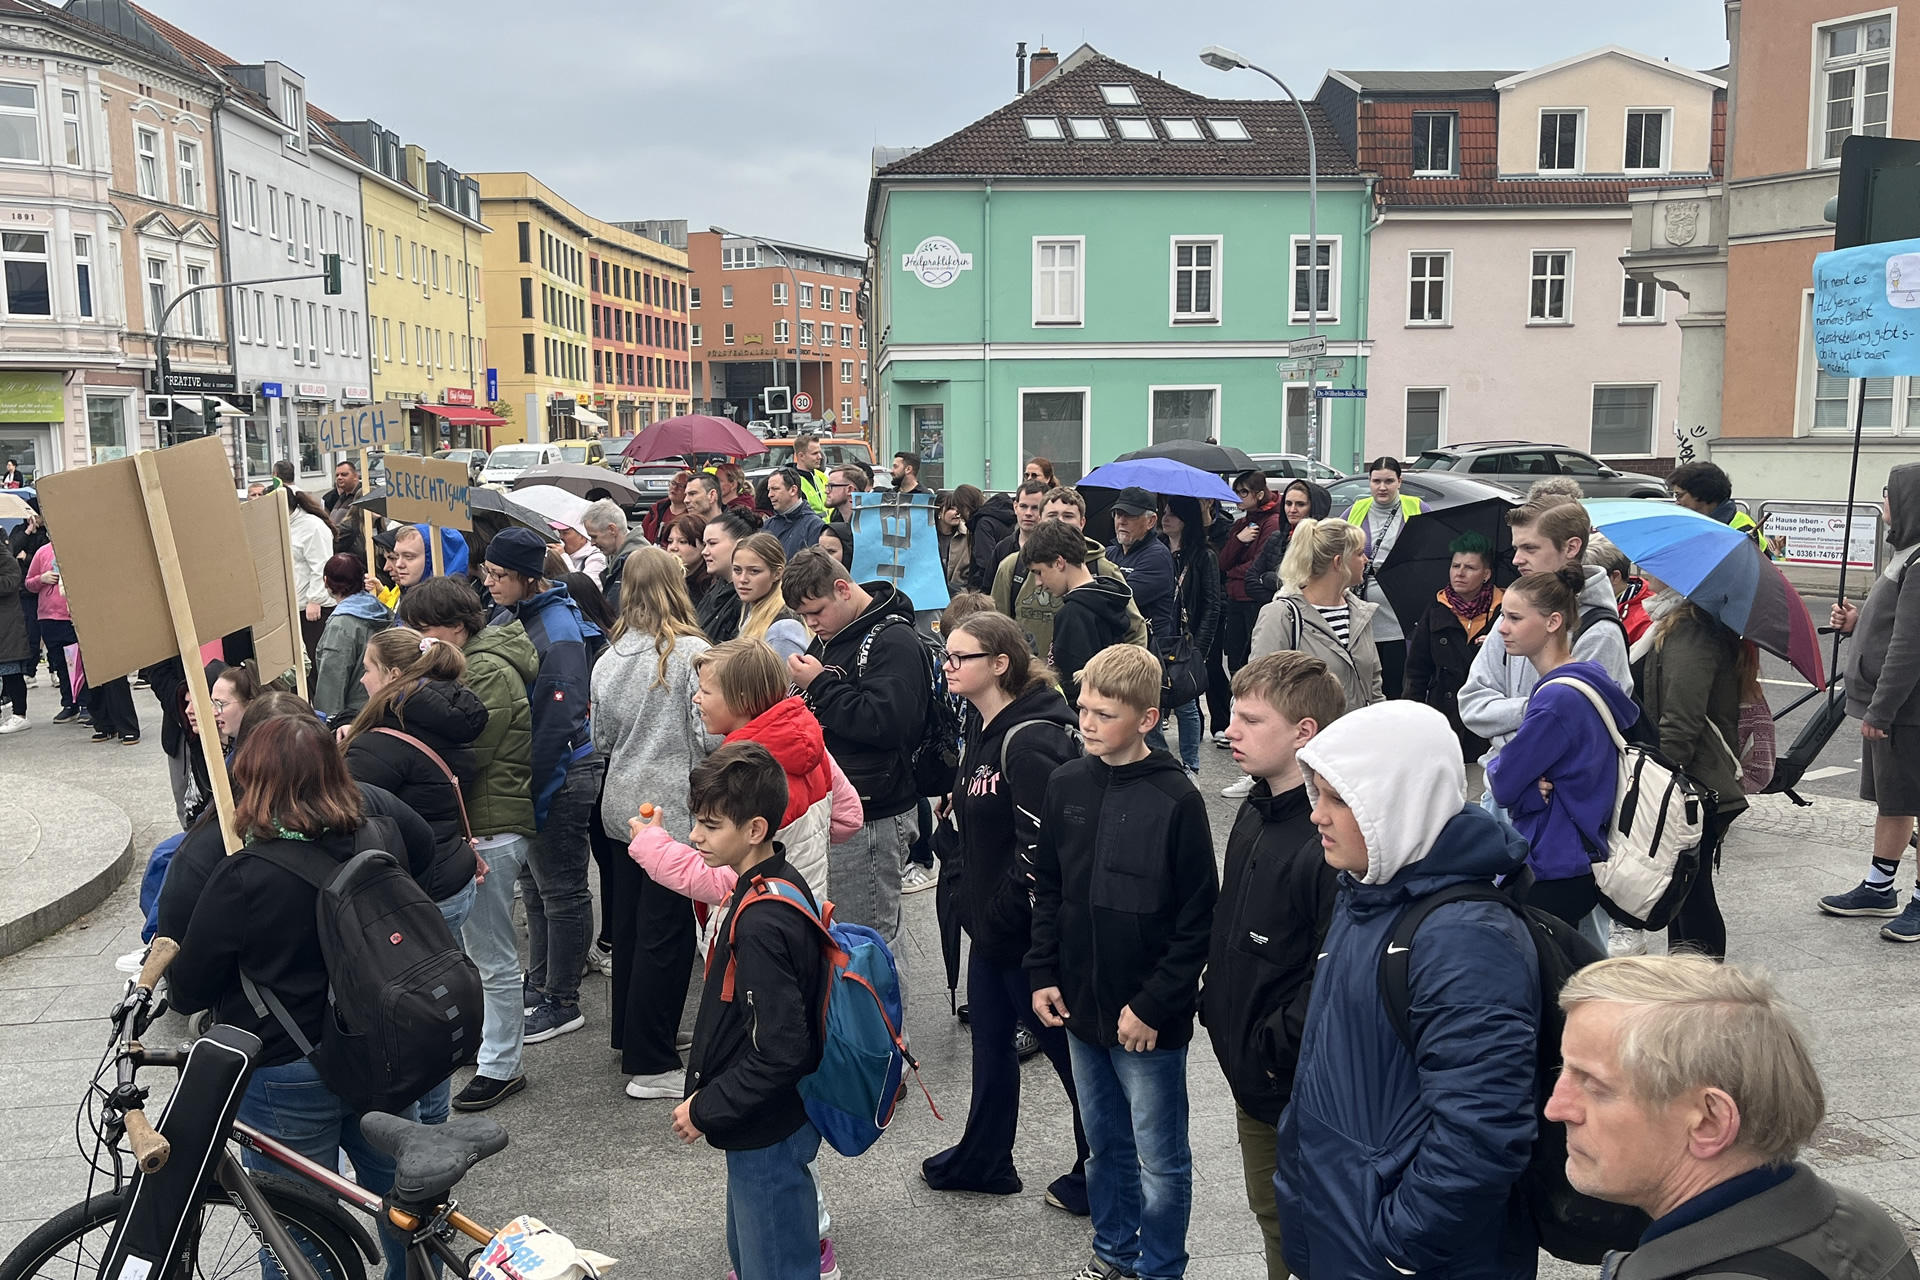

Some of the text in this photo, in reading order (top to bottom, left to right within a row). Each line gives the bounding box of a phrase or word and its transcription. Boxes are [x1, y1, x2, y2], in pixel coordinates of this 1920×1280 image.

[12, 213, 34, 221] 1891
[905, 255, 970, 271] Heilpraktikerin
[1853, 275, 1868, 285] es
[796, 397, 808, 407] 30
[320, 410, 399, 451] GLEICH-
[1775, 516, 1797, 524] Hause
[1799, 517, 1819, 525] leben
[1798, 526, 1826, 534] pflegen
